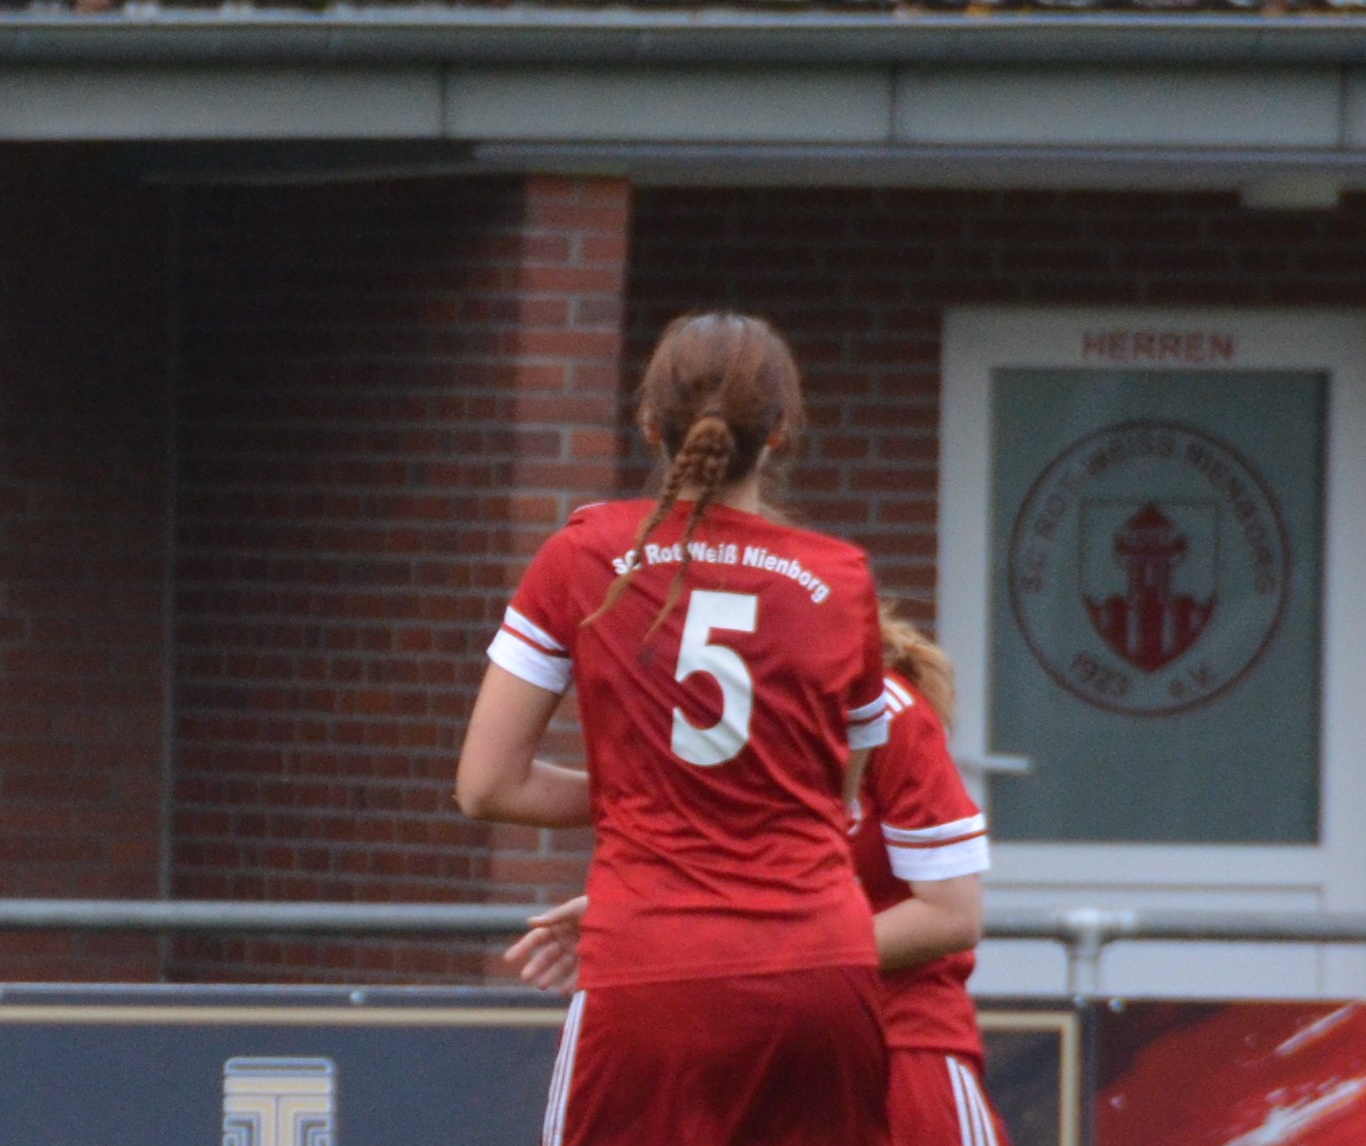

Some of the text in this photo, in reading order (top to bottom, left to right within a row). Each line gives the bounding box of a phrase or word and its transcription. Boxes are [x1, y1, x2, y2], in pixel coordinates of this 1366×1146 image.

[1082, 329, 1236, 362] HERREN
[742, 546, 832, 604] Nienborg
[671, 590, 757, 766] 5
